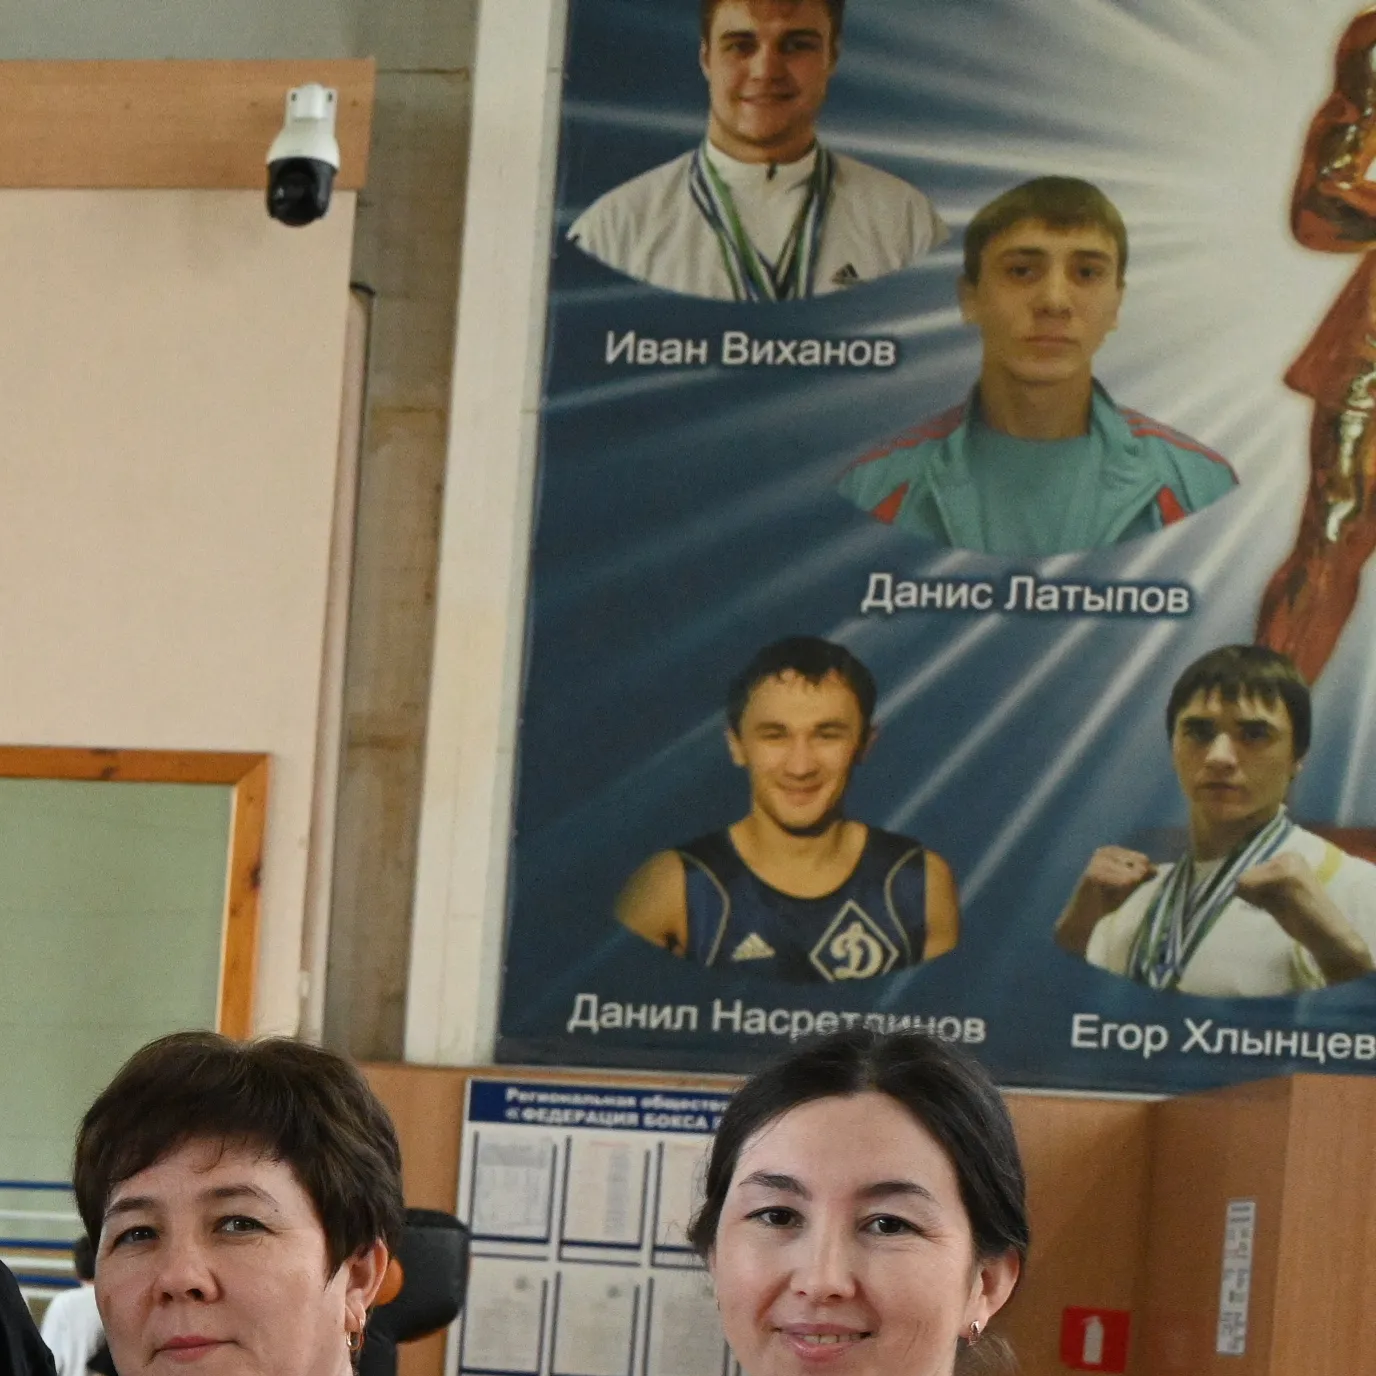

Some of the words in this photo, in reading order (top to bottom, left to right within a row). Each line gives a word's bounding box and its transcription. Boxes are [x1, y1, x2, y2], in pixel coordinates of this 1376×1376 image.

[605, 330, 708, 365] Иван
[721, 331, 896, 367] Виханов
[860, 572, 994, 614] Данис
[1004, 575, 1190, 614] Латыпов
[566, 993, 699, 1034] Данил
[1070, 1012, 1170, 1060] Егор
[1180, 1017, 1376, 1065] Хлынцев
